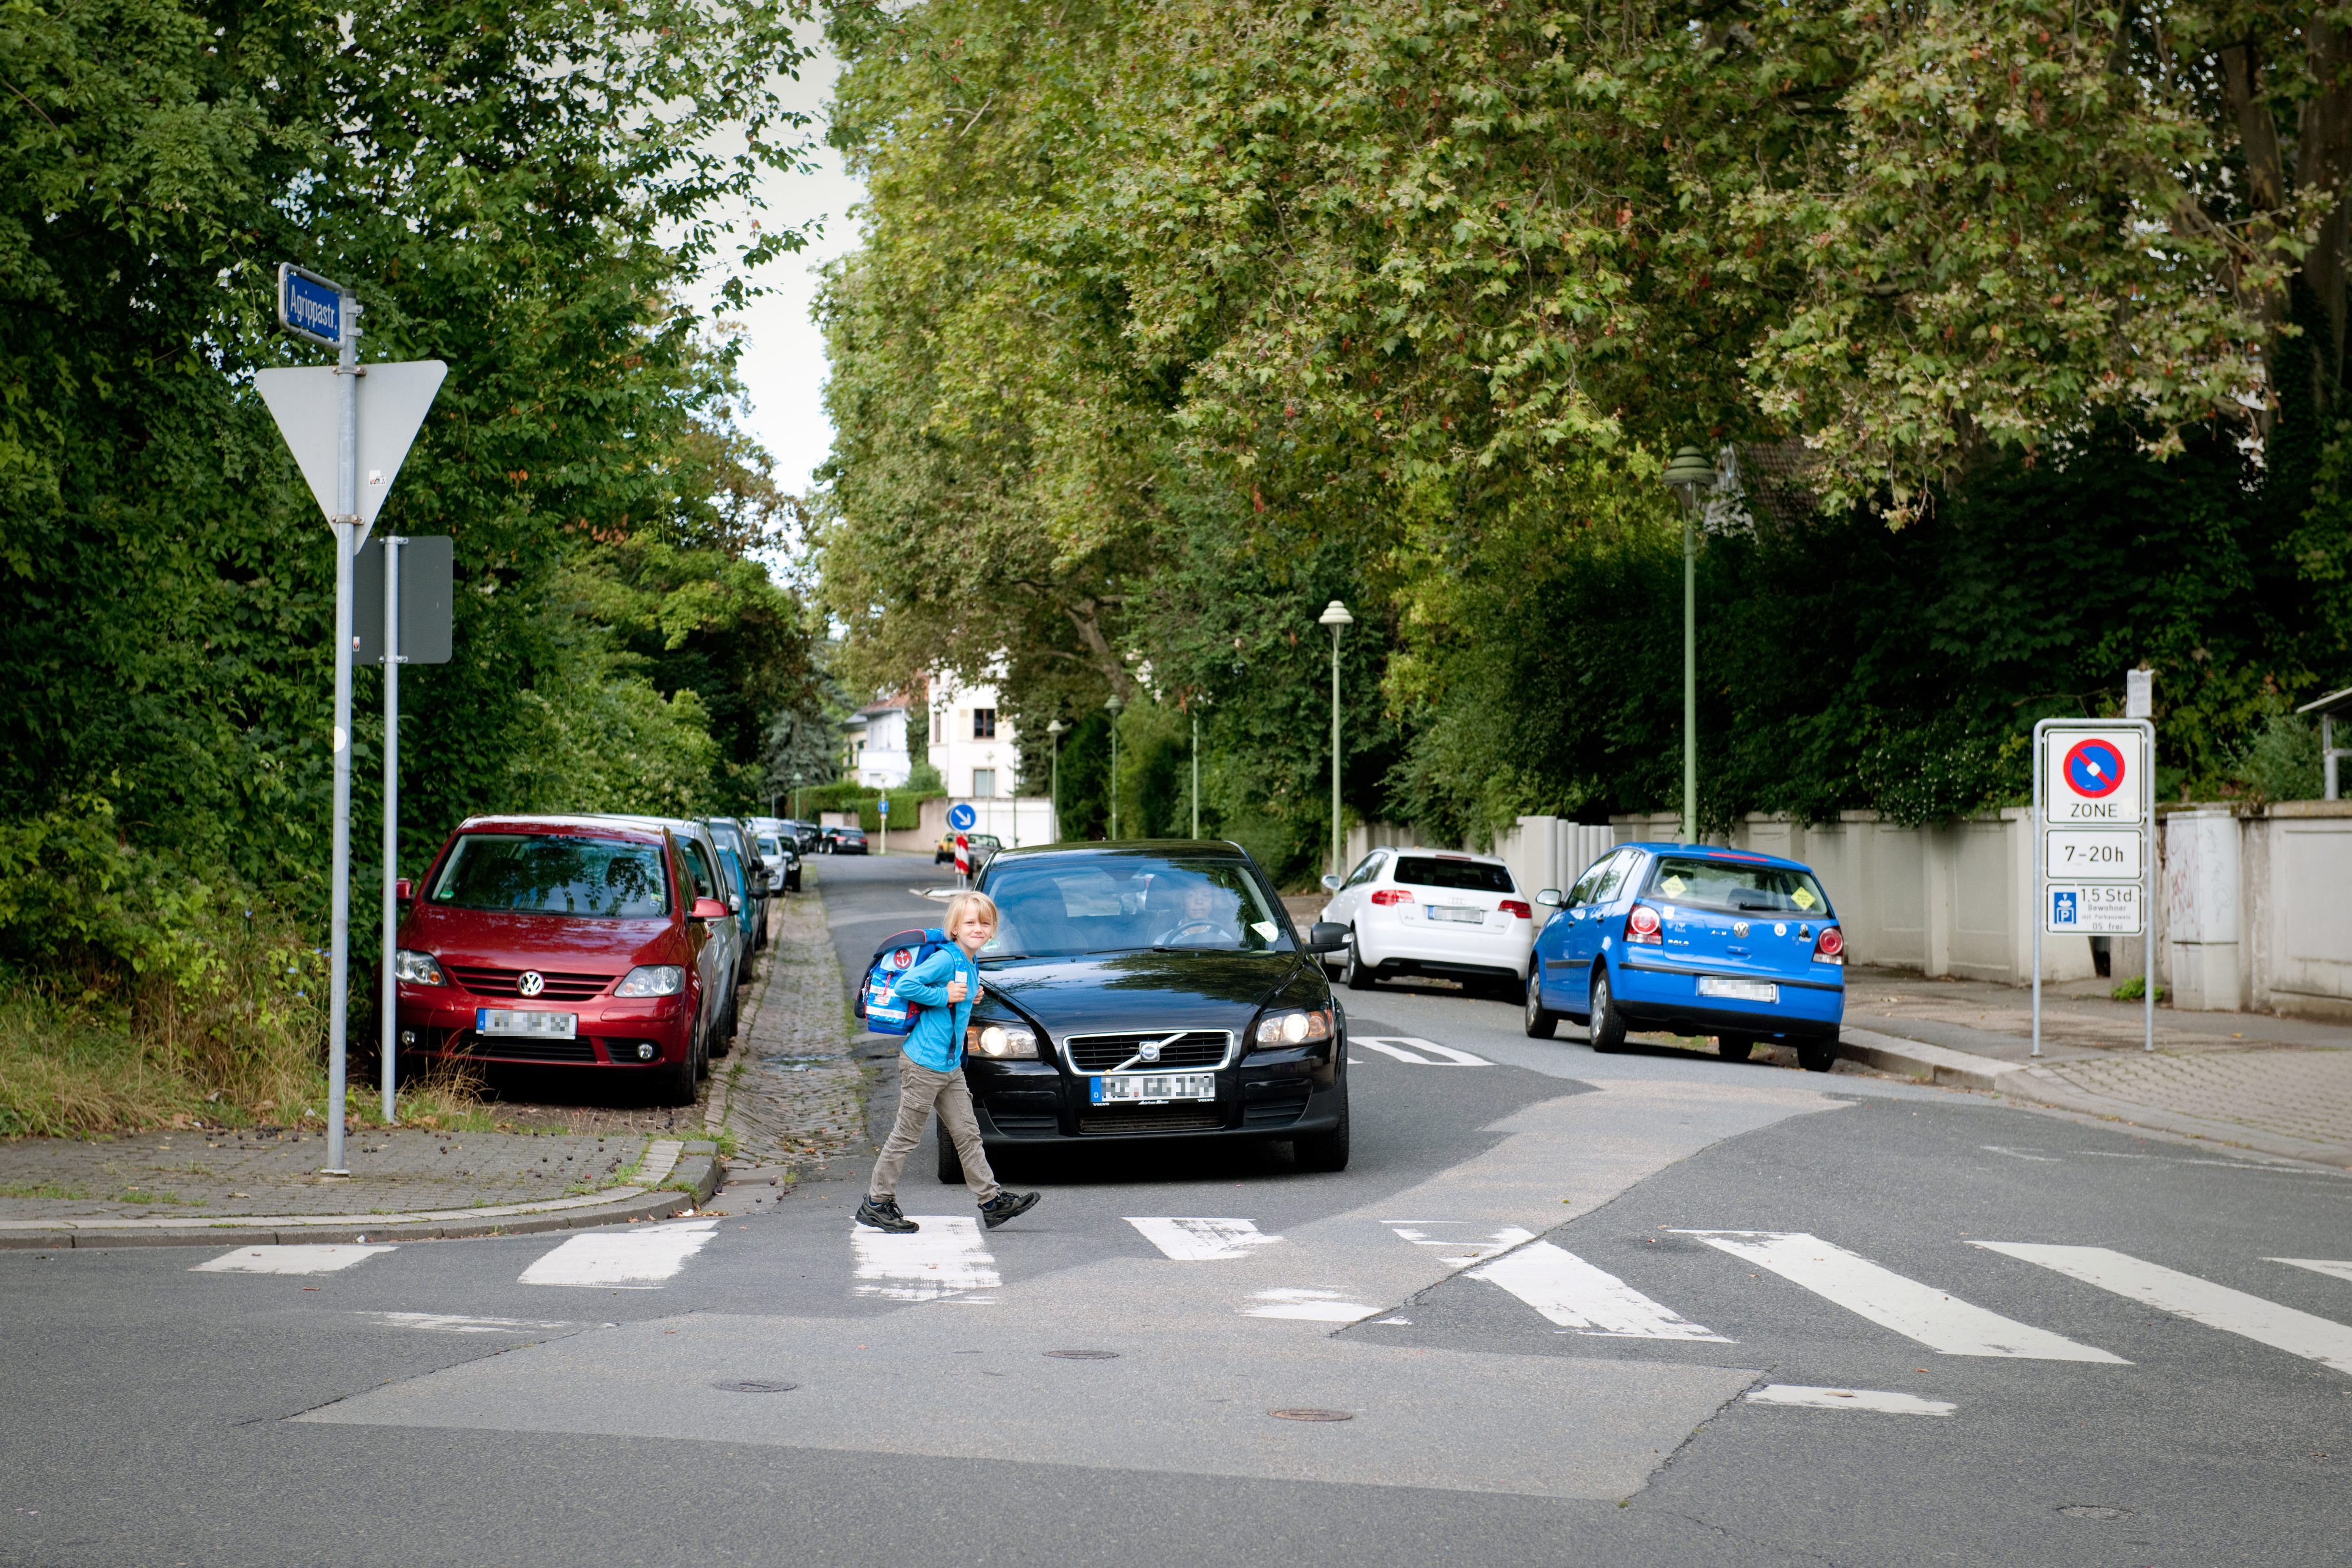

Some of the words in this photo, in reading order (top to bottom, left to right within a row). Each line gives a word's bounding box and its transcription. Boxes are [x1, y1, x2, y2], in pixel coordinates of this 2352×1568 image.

[290, 284, 338, 330] Agrippastr.
[2070, 803, 2117, 817] ZONE
[2081, 888, 2100, 902] 1.5
[2106, 888, 2136, 902] Std.
[2061, 910, 2070, 921] P
